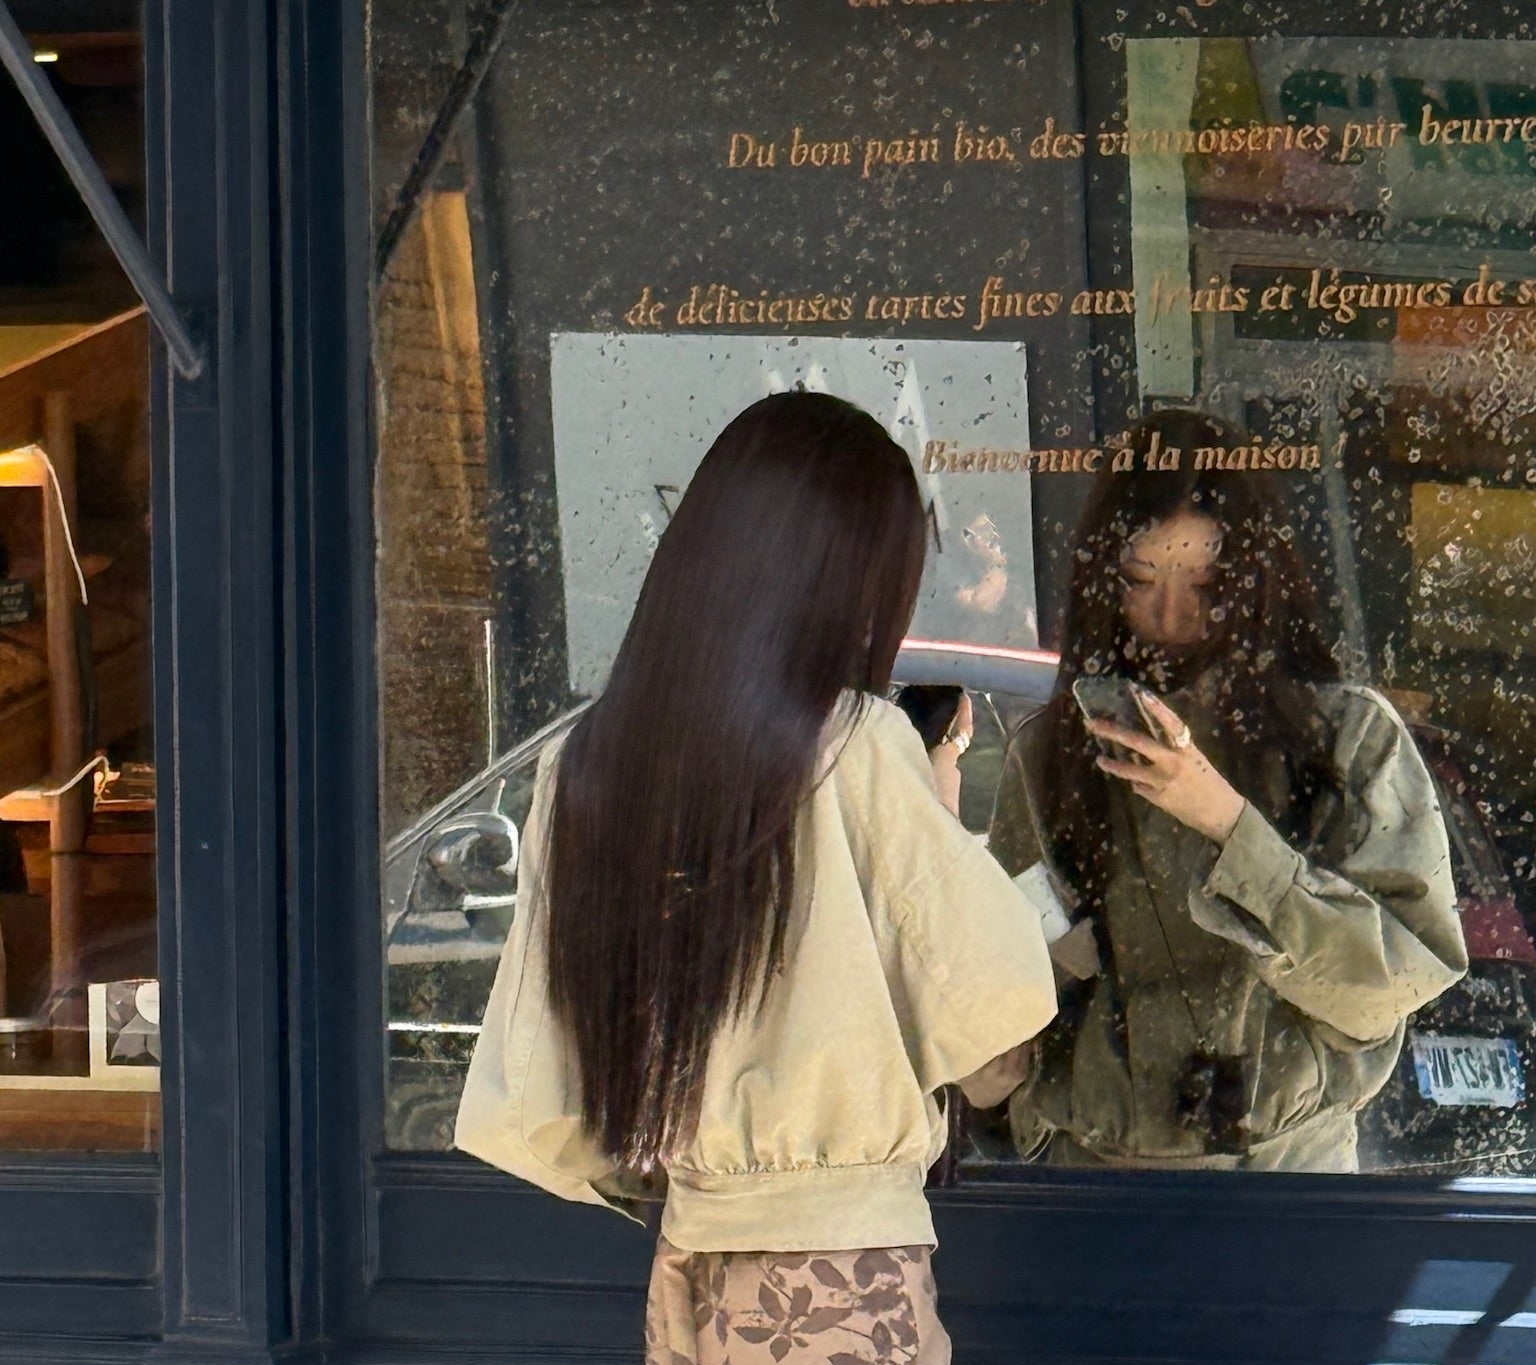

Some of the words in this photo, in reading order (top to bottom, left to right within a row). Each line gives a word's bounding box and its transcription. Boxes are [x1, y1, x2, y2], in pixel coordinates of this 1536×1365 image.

[727, 132, 777, 169] Du
[789, 126, 851, 168] bon
[861, 129, 939, 180] pain
[1029, 117, 1085, 160] des
[1098, 114, 1329, 157] viennoiseries
[1340, 120, 1406, 163] pur
[625, 286, 663, 327] de
[676, 284, 854, 326] délicieuses
[865, 291, 966, 324] tartes
[973, 275, 1061, 332] fines
[1070, 289, 1135, 316] aux
[1260, 281, 1299, 312] et
[1306, 267, 1453, 324] légumes
[1462, 263, 1505, 307] de
[922, 439, 1103, 474] Bienvenue
[1146, 431, 1181, 472] la
[1194, 436, 1320, 471] maison
